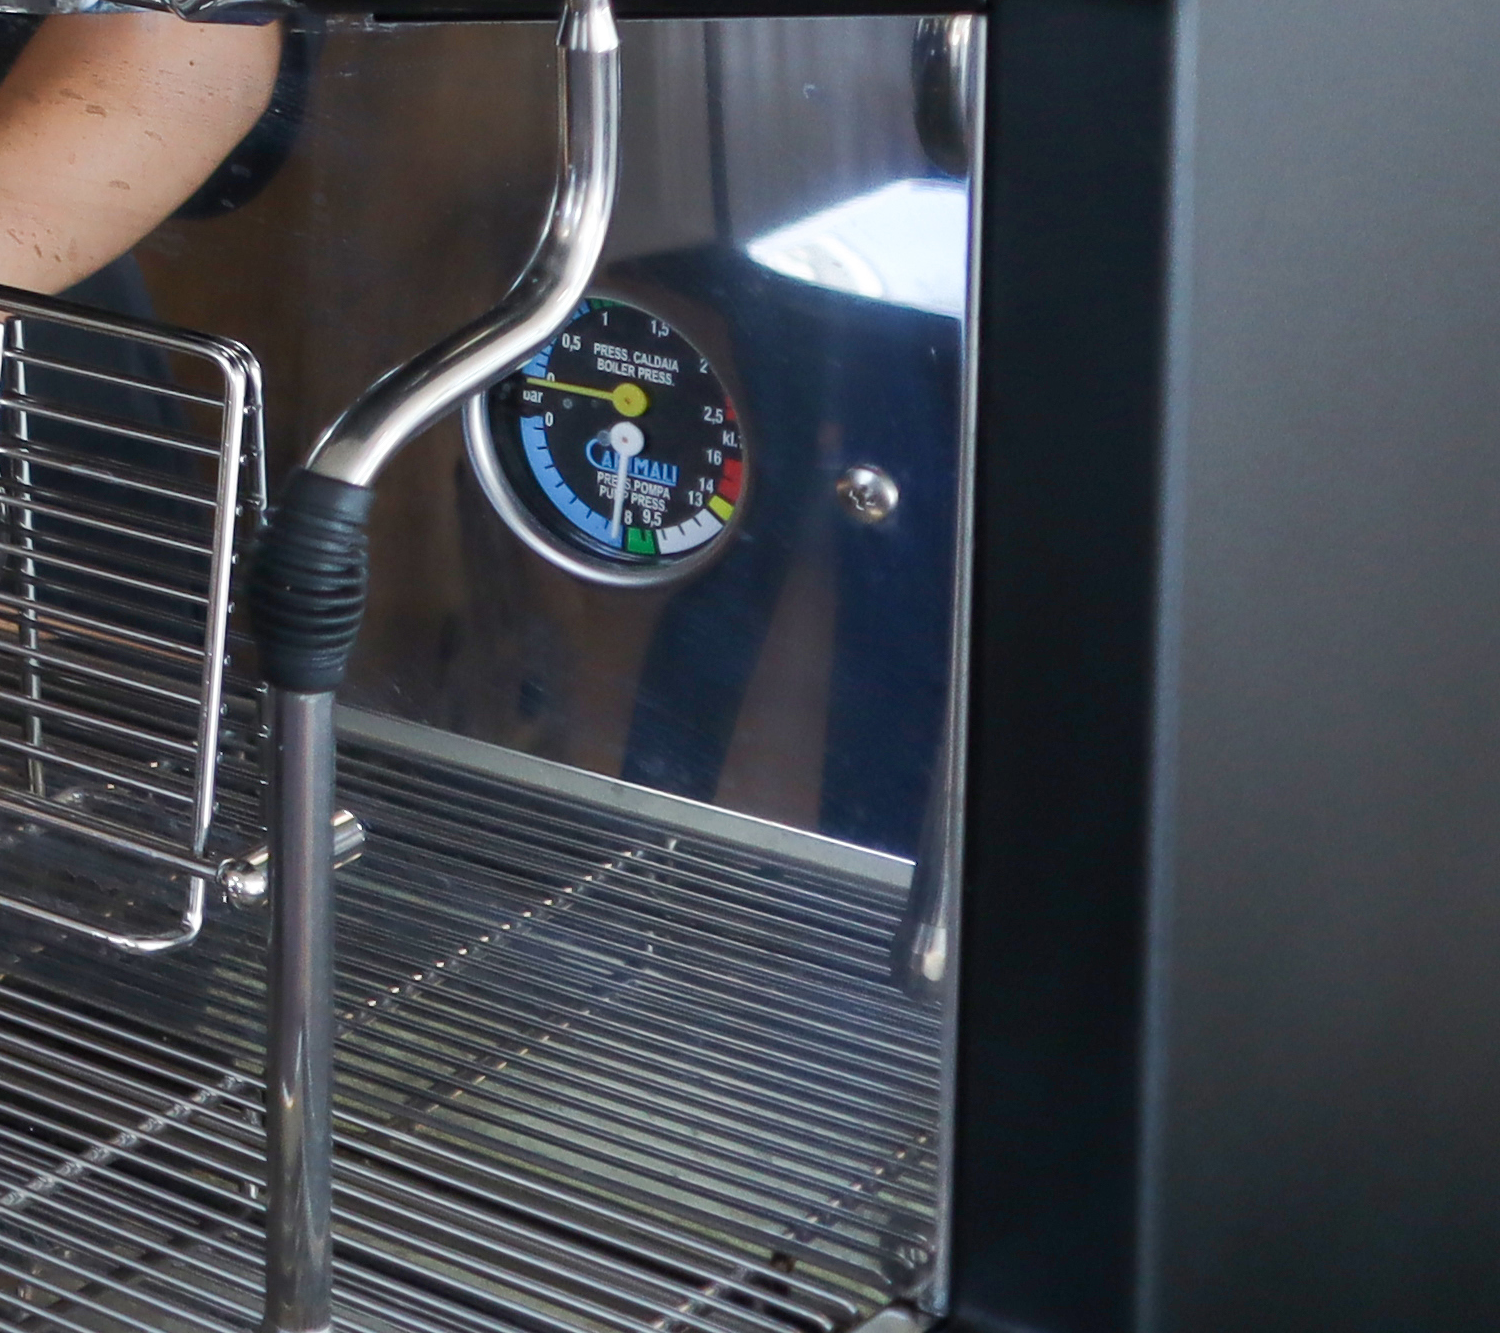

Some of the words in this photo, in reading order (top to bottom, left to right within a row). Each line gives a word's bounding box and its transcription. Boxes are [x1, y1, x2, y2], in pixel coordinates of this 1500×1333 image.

[602, 311, 609, 326] 1
[651, 319, 669, 337] 1,5
[562, 333, 581, 352] 0,5
[594, 342, 631, 362] PRESS.
[633, 352, 679, 373] CALDAIA
[700, 358, 708, 374] 2
[597, 358, 636, 377] BOILER
[637, 367, 675, 387] PRESS.
[545, 412, 553, 426] 0
[703, 406, 723, 425] 2,5
[706, 449, 722, 465] 16
[597, 471, 634, 491] PRES.
[634, 479, 671, 500] POMPA
[699, 477, 714, 493] 14
[599, 484, 629, 500] PUP
[630, 492, 668, 512] PRESS.
[688, 491, 703, 507] 13
[624, 510, 633, 525] 8
[642, 509, 662, 527] 9,5
